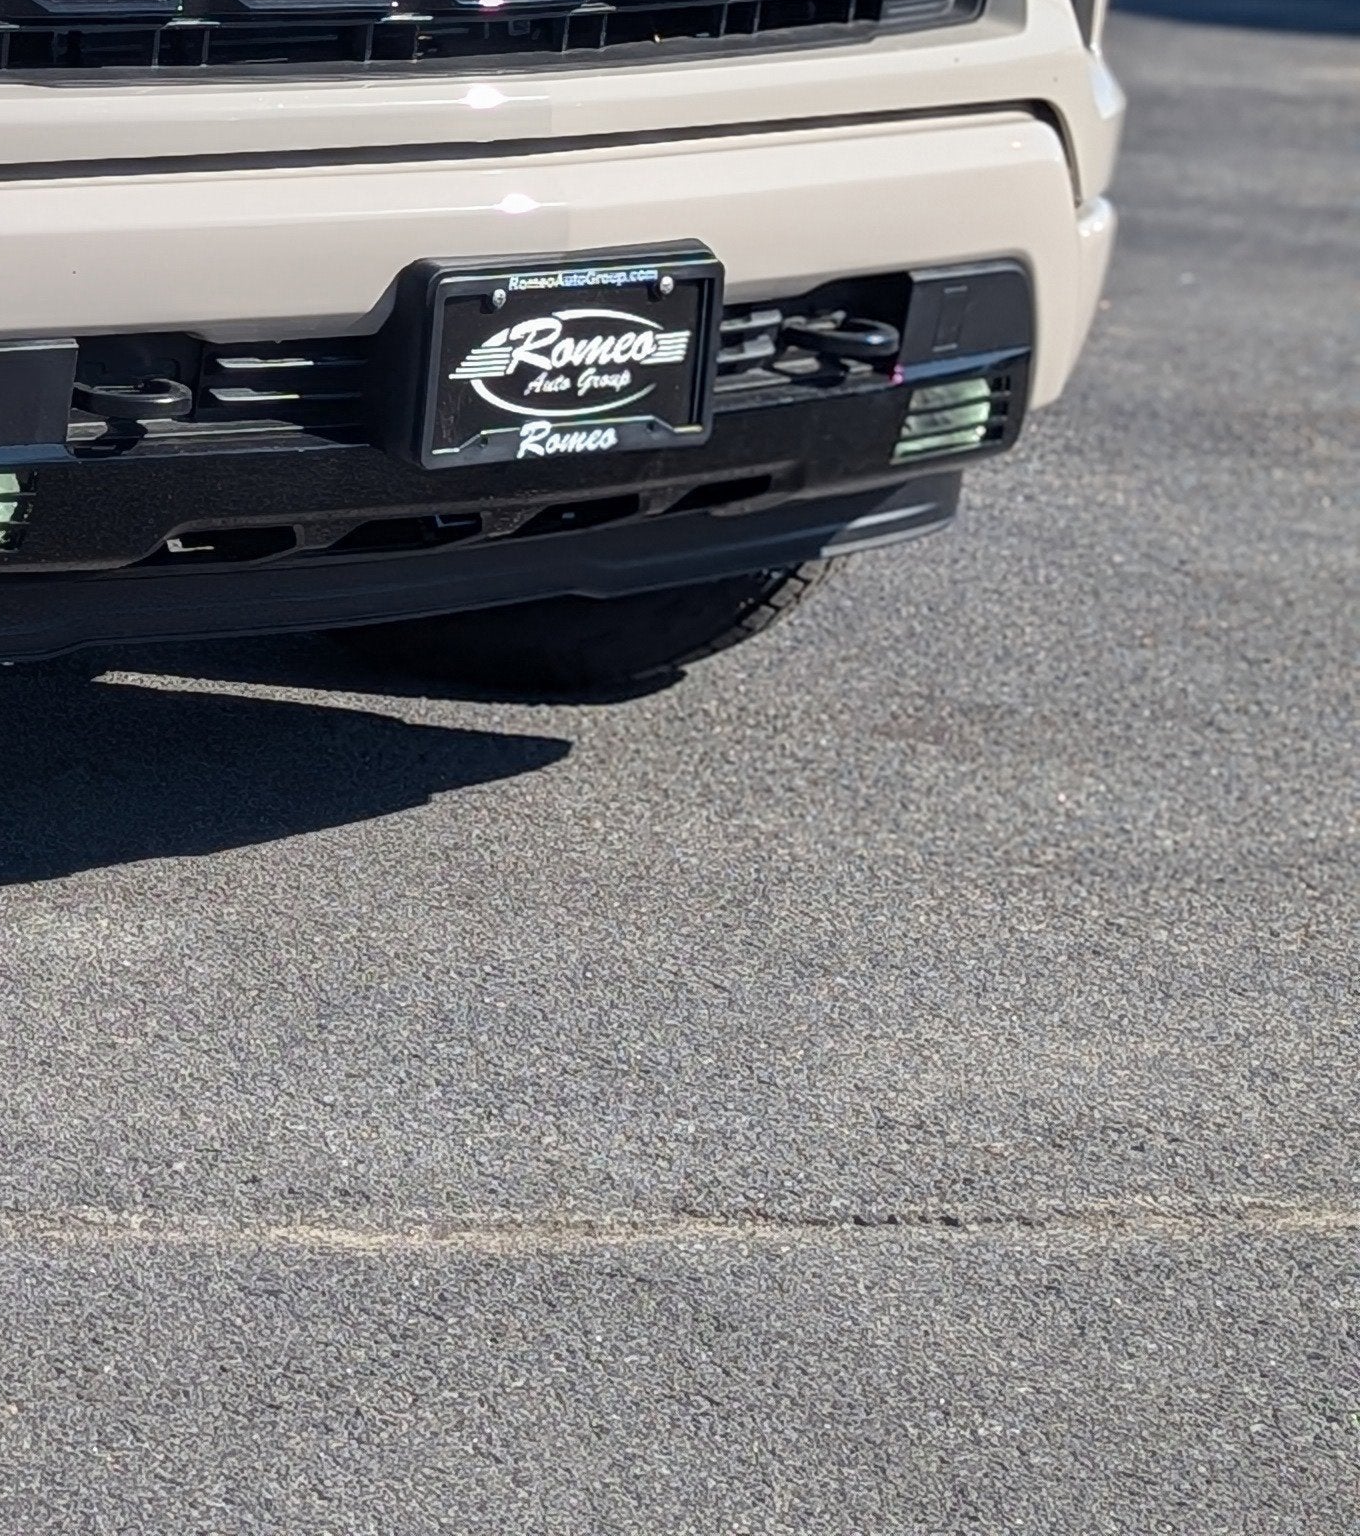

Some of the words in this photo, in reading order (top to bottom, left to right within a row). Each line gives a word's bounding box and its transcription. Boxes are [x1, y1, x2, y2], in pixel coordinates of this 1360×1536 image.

[508, 268, 659, 292] RomeoAutoGroup.com
[506, 316, 658, 375] Romeo
[523, 370, 571, 396] Auto
[577, 367, 633, 396] Group
[516, 420, 618, 459] Romeo
